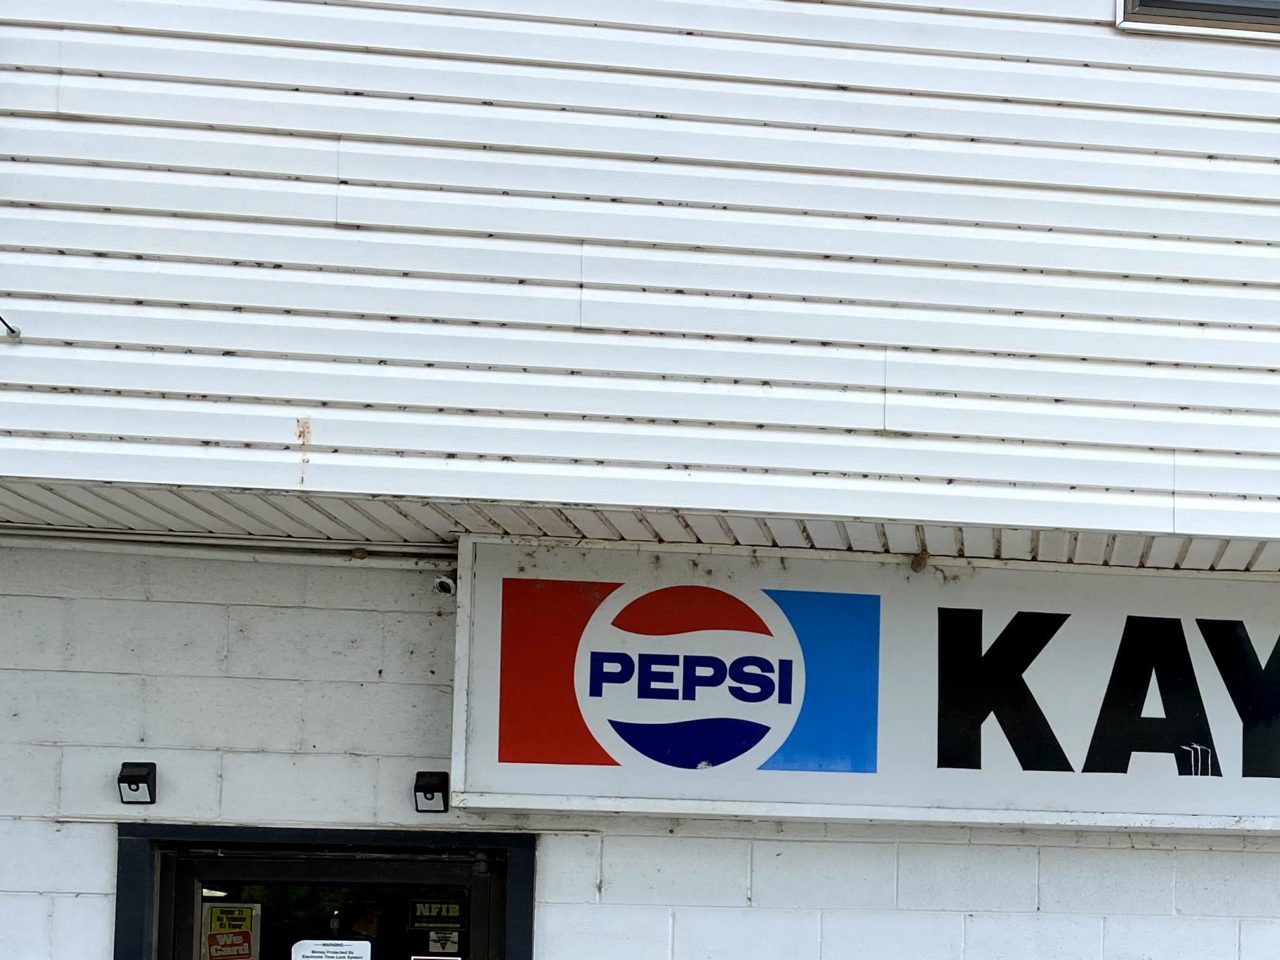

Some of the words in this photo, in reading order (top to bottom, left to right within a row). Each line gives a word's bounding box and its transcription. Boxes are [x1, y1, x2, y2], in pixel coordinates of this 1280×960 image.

[588, 651, 793, 705] PEPSI
[415, 903, 460, 917] NFIB
[216, 933, 243, 945] We
